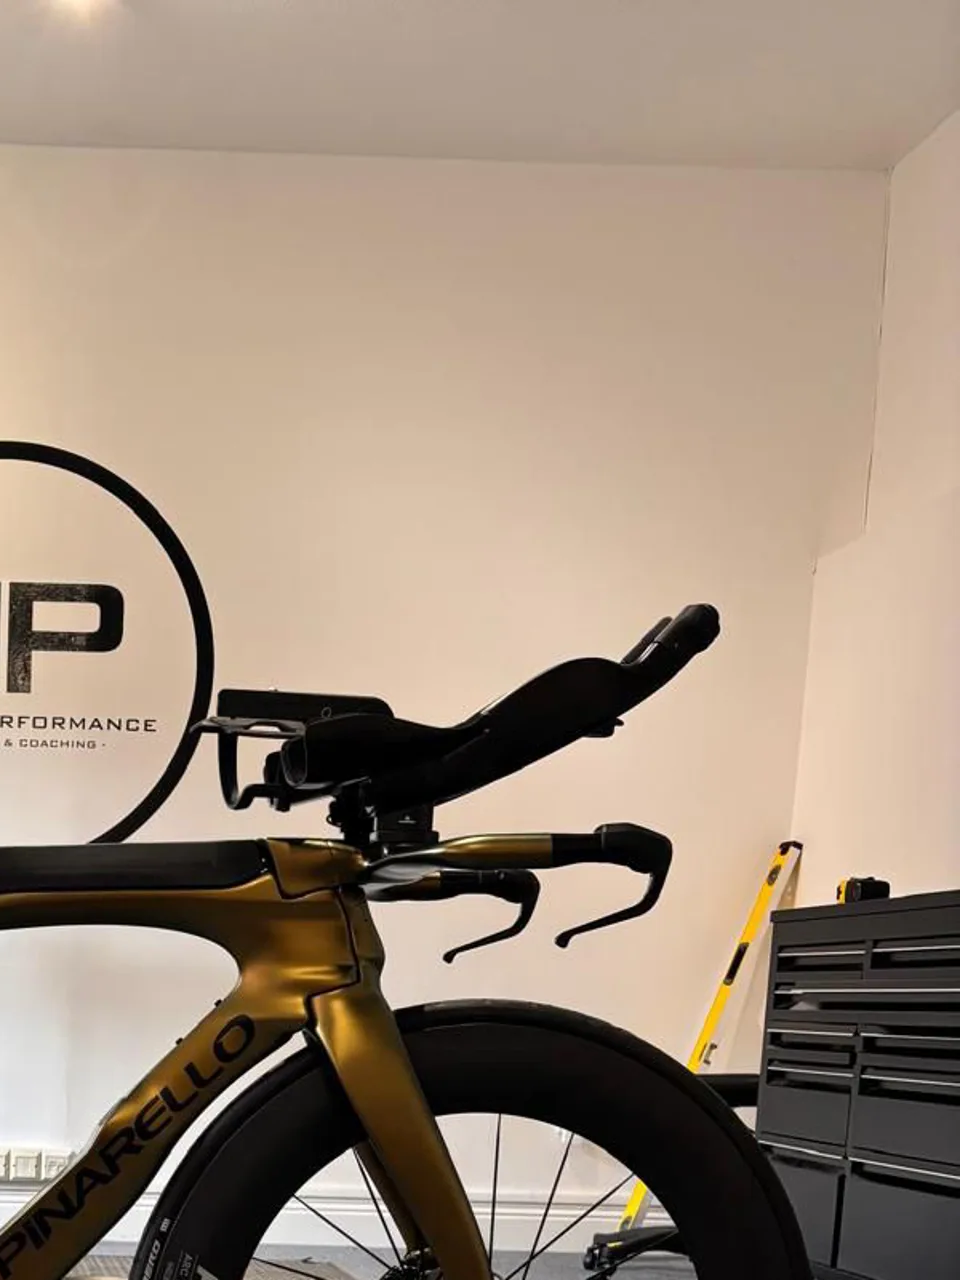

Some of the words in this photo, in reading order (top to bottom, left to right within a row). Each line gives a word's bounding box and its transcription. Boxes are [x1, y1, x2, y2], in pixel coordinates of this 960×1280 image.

[3, 738, 13, 748] &
[19, 738, 97, 750] COACHING
[180, 1252, 193, 1277] ARC
